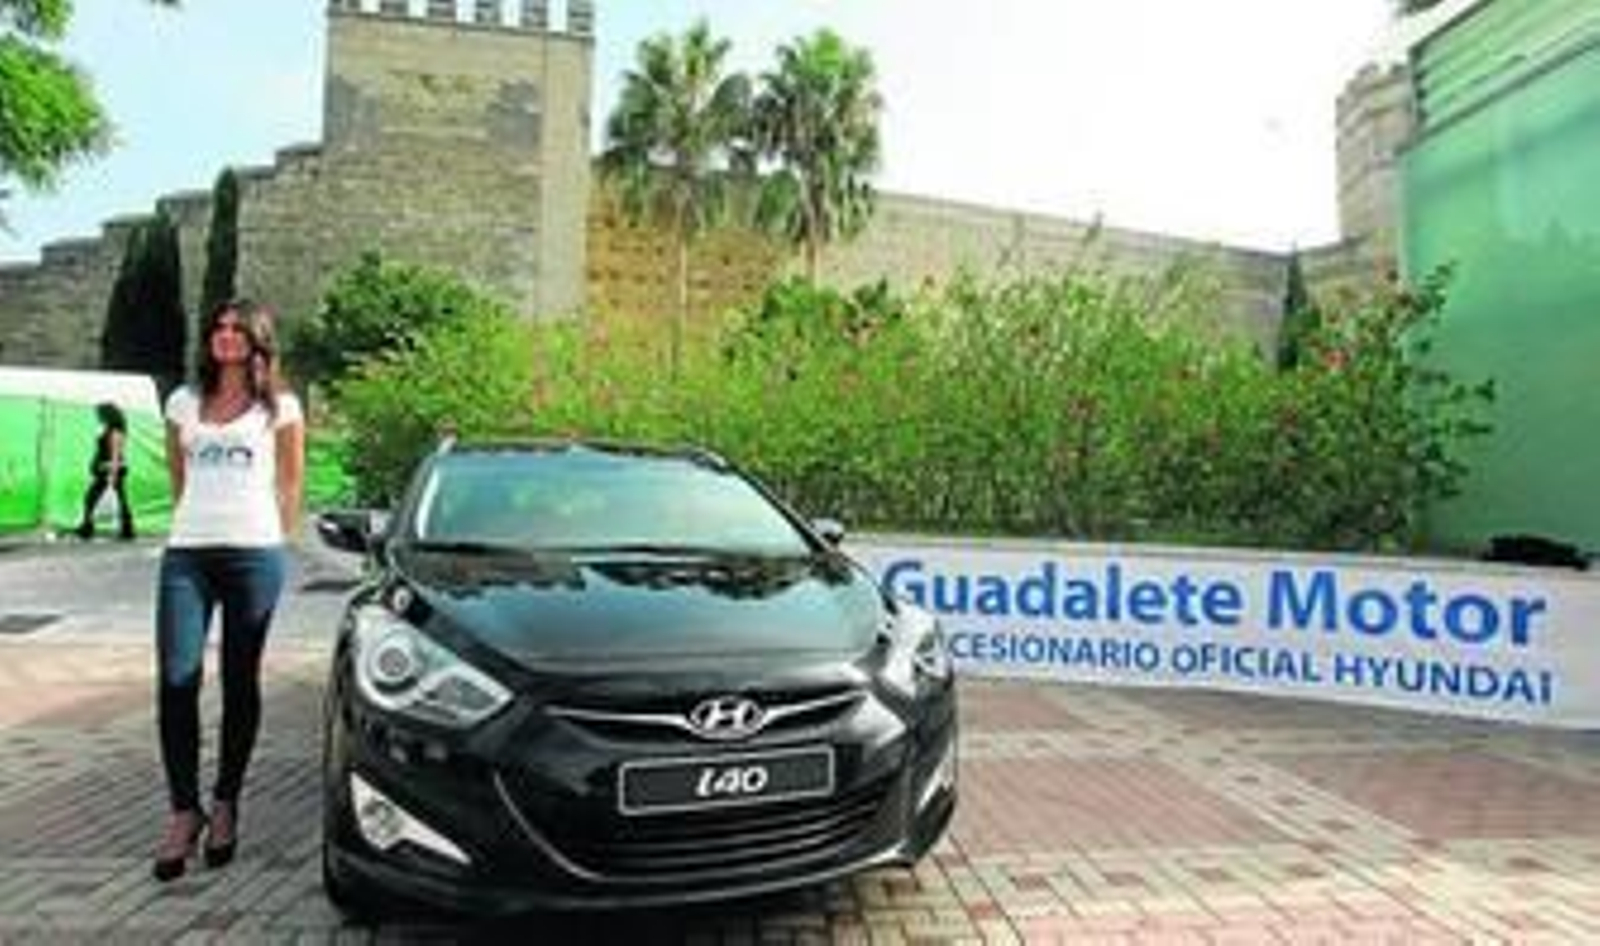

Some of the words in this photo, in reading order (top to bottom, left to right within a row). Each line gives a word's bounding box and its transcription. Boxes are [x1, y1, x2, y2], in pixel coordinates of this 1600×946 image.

[881, 559, 1242, 625] Guadalete
[1267, 569, 1546, 645] Motor
[947, 632, 1160, 671] CESIONARIO
[1172, 642, 1321, 682] OFICIAL
[1334, 655, 1553, 704] HYUNDAI
